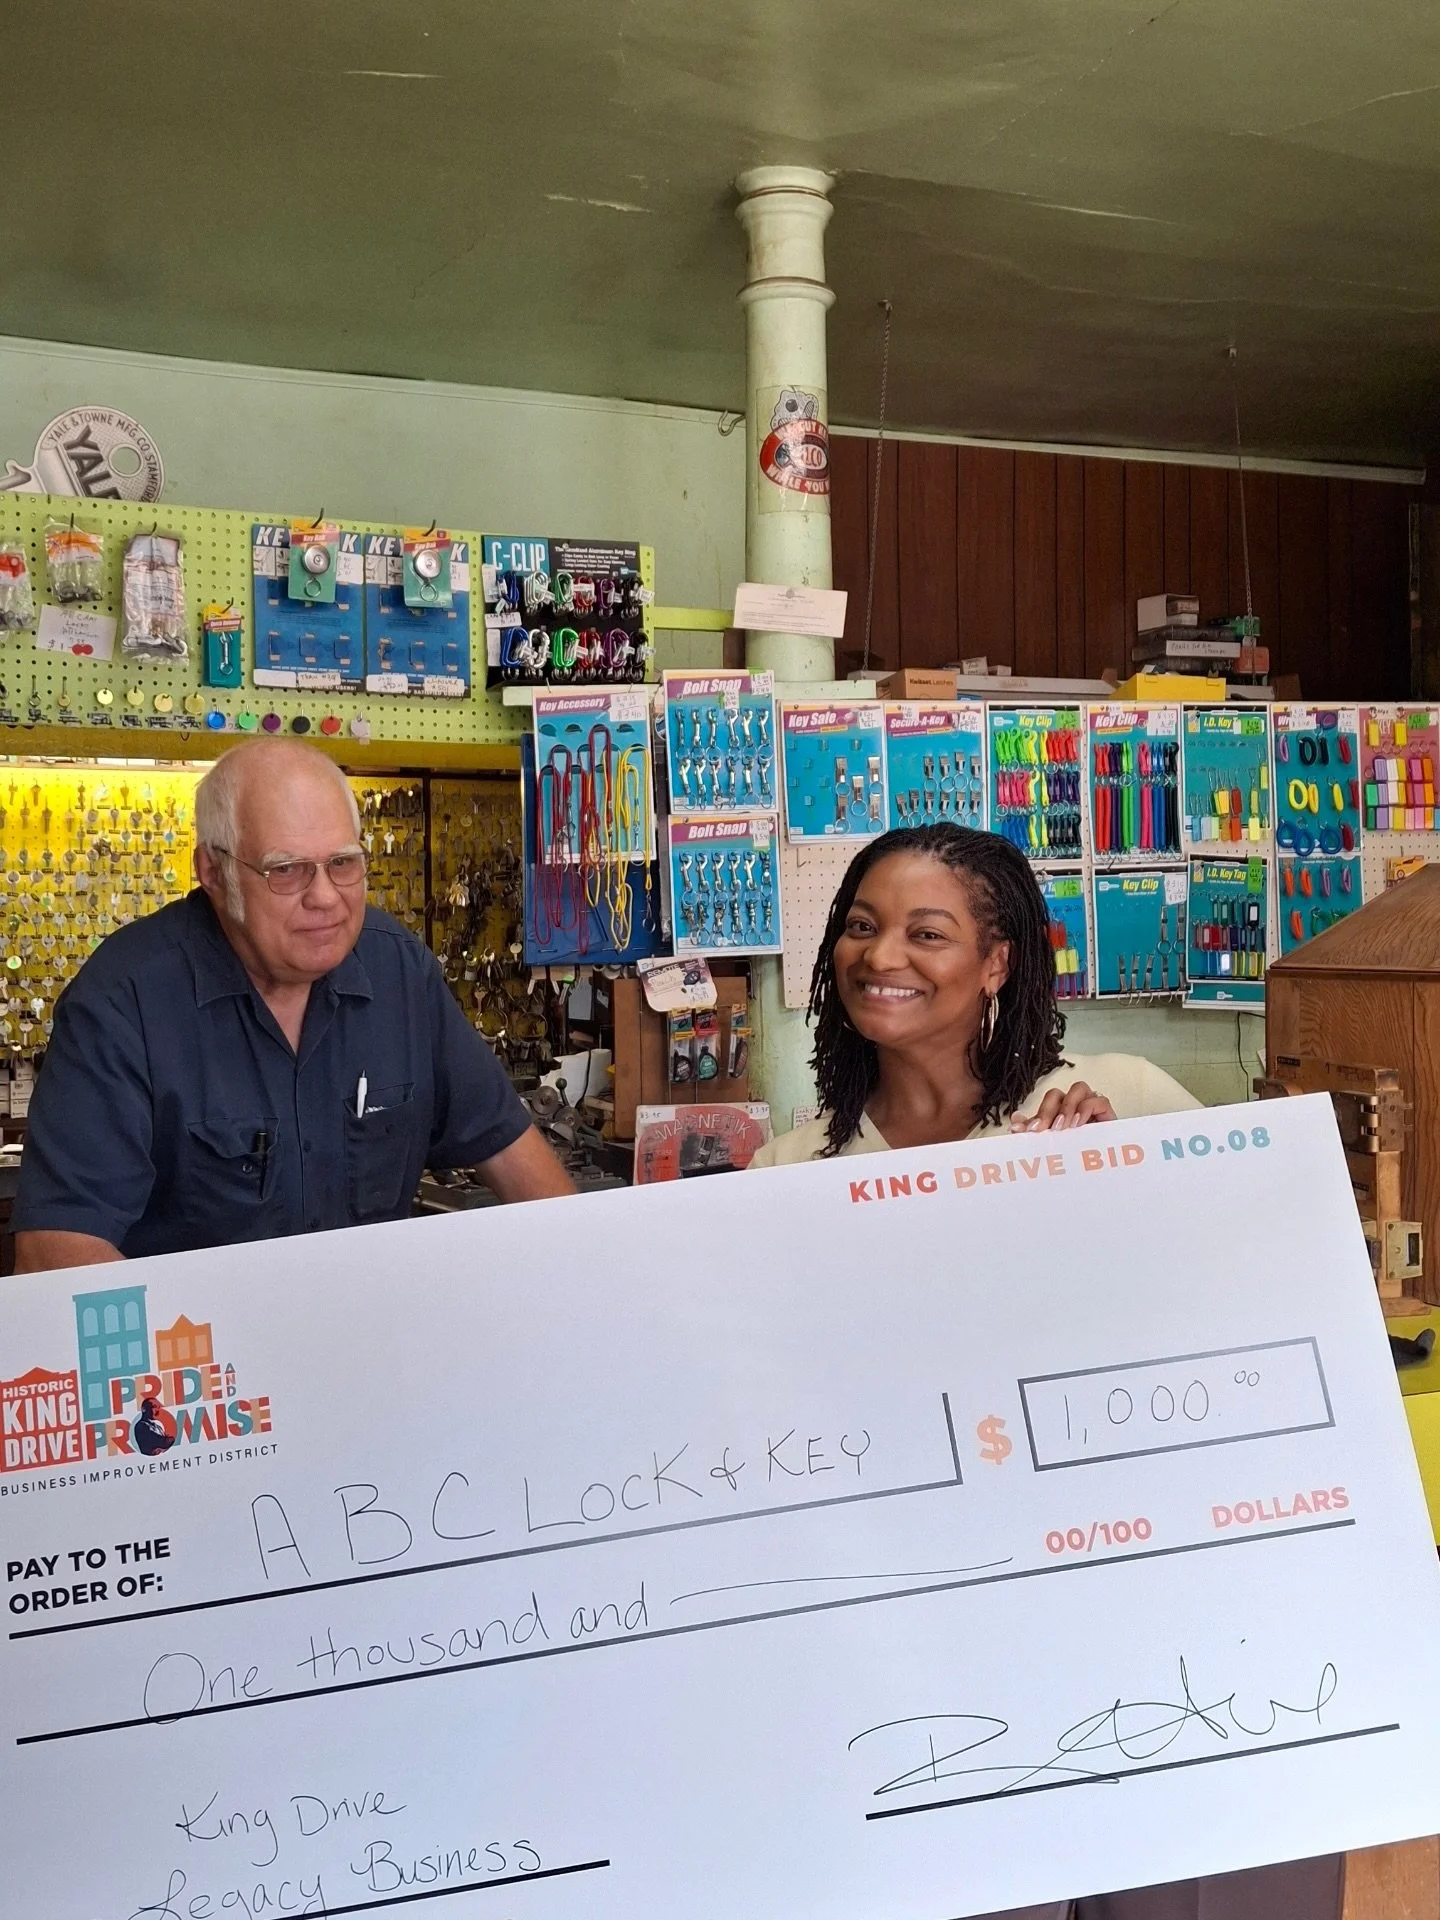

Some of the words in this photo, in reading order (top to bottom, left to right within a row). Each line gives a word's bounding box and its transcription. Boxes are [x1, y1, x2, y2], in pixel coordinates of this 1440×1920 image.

[48, 425, 71, 442] YALE
[79, 411, 114, 426] TOWNE
[255, 525, 290, 547] KE
[367, 535, 403, 557] KE
[491, 541, 546, 571] C-CLIP
[683, 680, 709, 695] Bolt
[710, 678, 742, 693] Snap
[538, 700, 557, 712] Key
[557, 697, 605, 710] Accessory
[788, 714, 809, 728] Key
[810, 711, 836, 726] Safe
[1095, 714, 1117, 728] Key
[1118, 712, 1138, 726] Clip
[890, 714, 945, 729] Secure-A-Key
[1019, 715, 1035, 728] Key
[1035, 715, 1052, 728] Clip
[1218, 717, 1232, 728] Key
[688, 825, 714, 839] Bolt
[715, 822, 746, 836] Snap
[1122, 879, 1140, 892] Key
[1141, 878, 1159, 890] Clip
[1219, 868, 1232, 879] Key
[1233, 869, 1246, 881] Tag
[848, 1171, 939, 1204] KING
[953, 1153, 1067, 1190] DRIVE
[1080, 1143, 1146, 1173] BID
[1160, 1126, 1272, 1161] NO.08
[2, 1378, 75, 1399] HISTORIC
[111, 1364, 223, 1416] PRIDE
[2, 1391, 78, 1436] KING
[85, 1396, 273, 1461] PROMISE
[4, 1428, 80, 1469] DRIVE
[975, 1413, 1013, 1466] $
[1, 1475, 77, 1497] BUSINESS
[83, 1456, 203, 1485] IMPROVEMENT
[208, 1443, 279, 1465] DISTRICT
[251, 1494, 311, 1580] A
[335, 1483, 413, 1565] B
[432, 1472, 496, 1540] C
[766, 1428, 871, 1483] KEY
[1045, 1517, 1153, 1555] 00/100
[1211, 1486, 1351, 1529] DOLLARS
[6, 1554, 61, 1582] PAY
[68, 1547, 107, 1572] TO
[114, 1537, 171, 1564] THE
[9, 1580, 109, 1615] ORDER
[116, 1573, 164, 1598] OF:
[143, 1652, 274, 1725] One
[296, 1591, 550, 1680] thousand
[569, 1581, 649, 1639] and
[175, 1791, 279, 1867] King
[289, 1791, 407, 1836] Drive
[350, 1839, 541, 1893] Business
